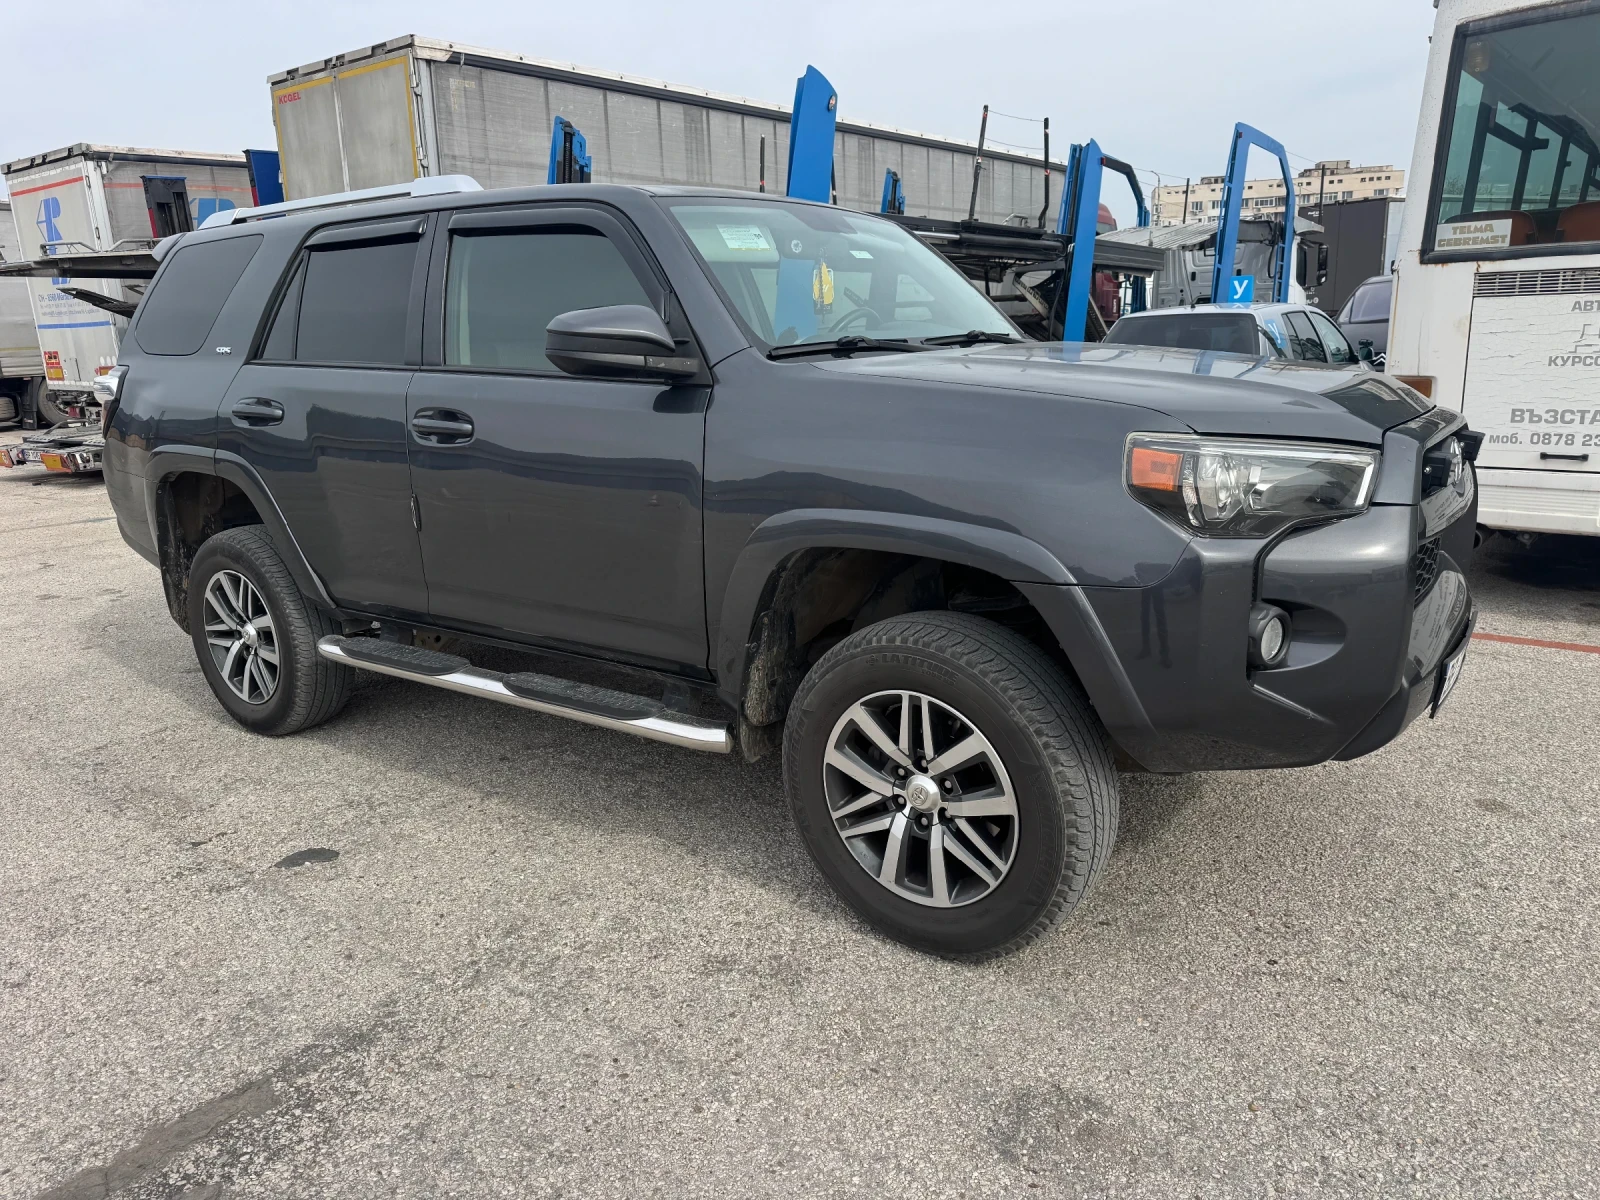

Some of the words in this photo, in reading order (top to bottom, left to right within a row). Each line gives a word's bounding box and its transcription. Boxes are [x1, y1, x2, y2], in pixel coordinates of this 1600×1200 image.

[1451, 223, 1495, 236] TELMA
[1437, 234, 1509, 248] GEBREMST
[1510, 408, 1600, 425] ВЪЗСТА
[1488, 432, 1523, 445] моб.
[1529, 432, 1576, 446] 0878
